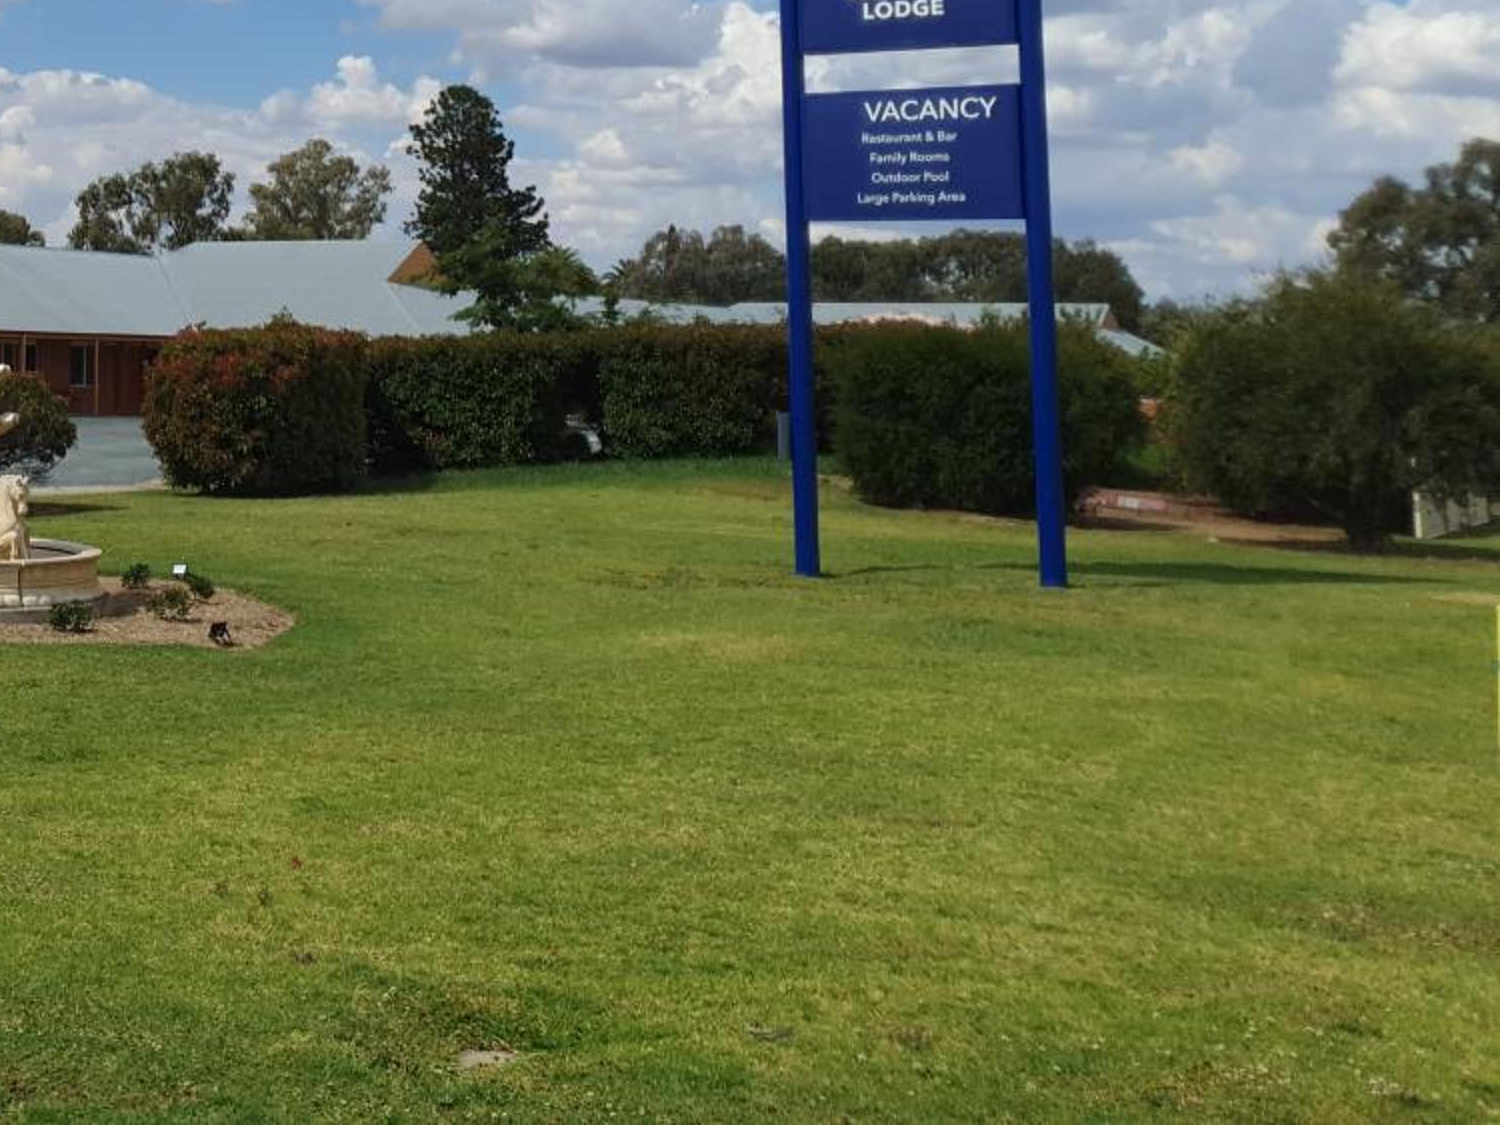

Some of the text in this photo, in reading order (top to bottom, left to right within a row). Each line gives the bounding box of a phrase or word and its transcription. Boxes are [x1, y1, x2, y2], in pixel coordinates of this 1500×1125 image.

[863, 96, 997, 123] VACANCY
[861, 131, 923, 144] Restaurant
[937, 130, 958, 142] Bar
[869, 151, 950, 165] Family Rooms
[871, 170, 949, 184] Outdoor Pool
[857, 190, 967, 206] Large Parking Area
